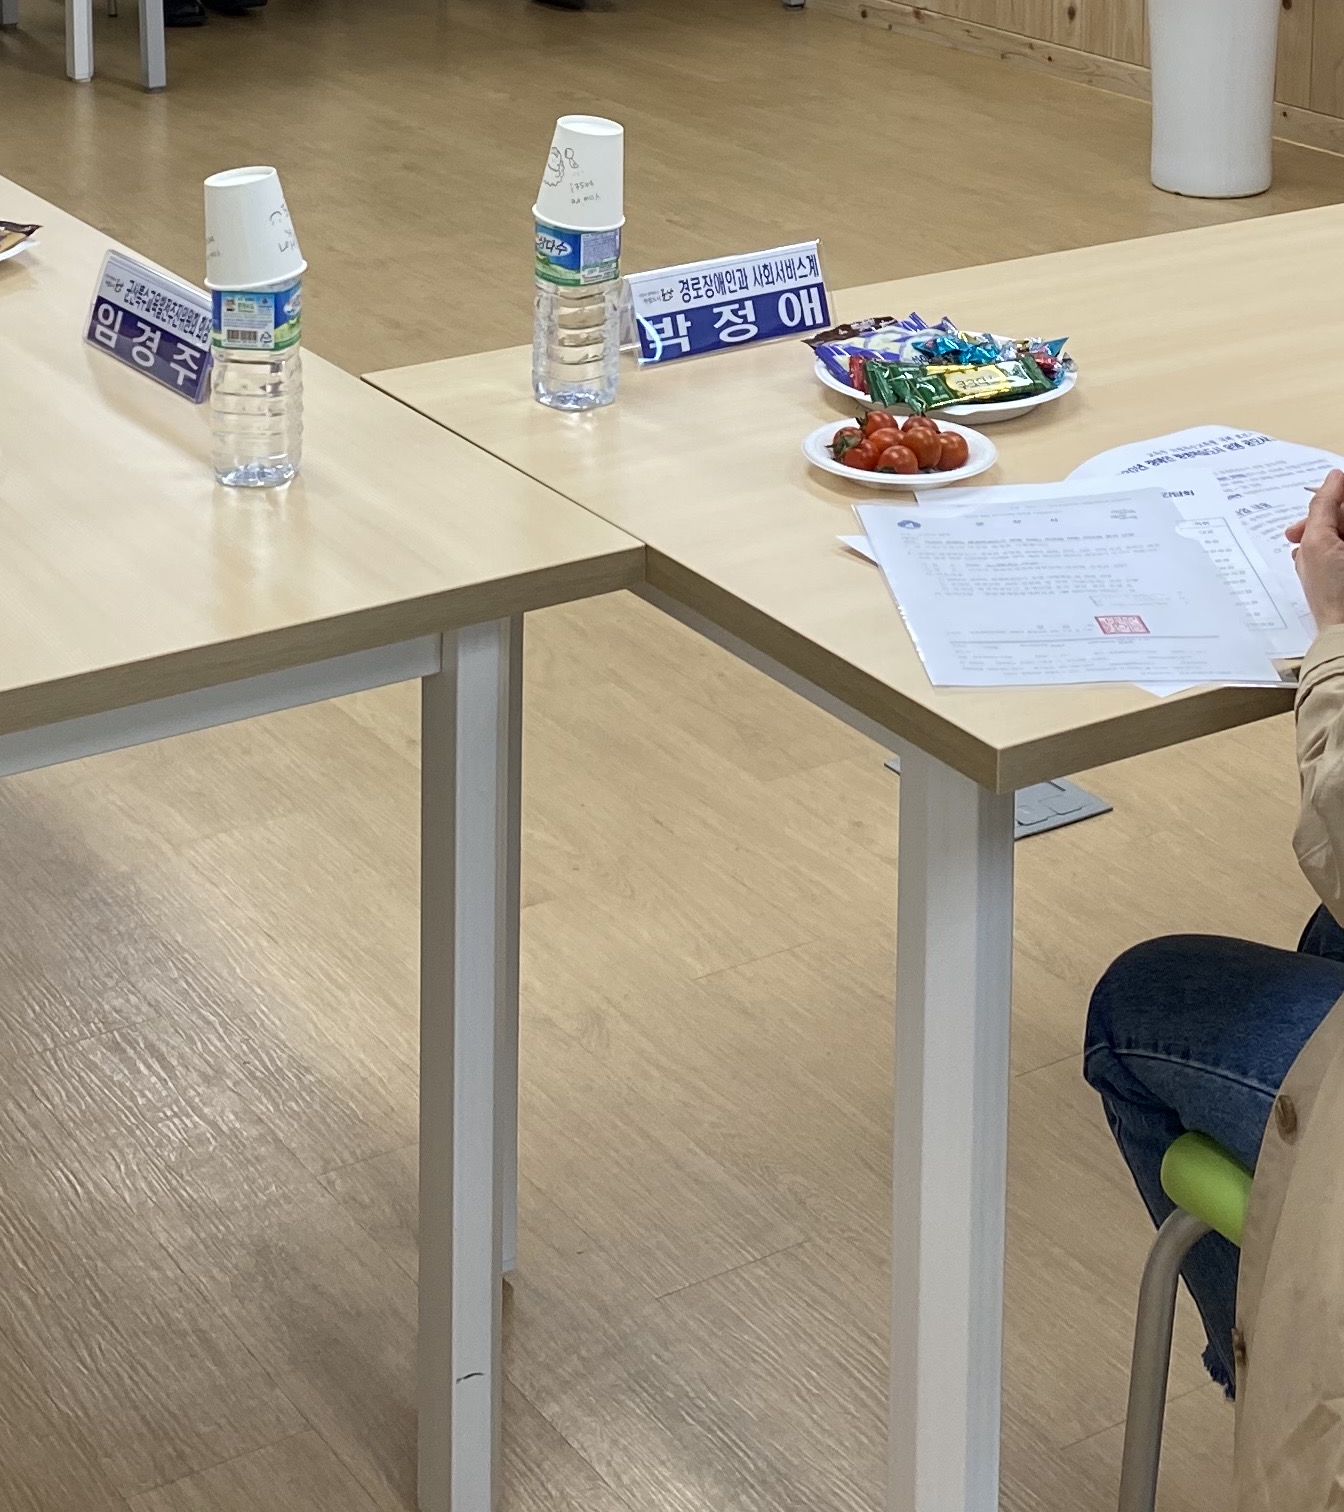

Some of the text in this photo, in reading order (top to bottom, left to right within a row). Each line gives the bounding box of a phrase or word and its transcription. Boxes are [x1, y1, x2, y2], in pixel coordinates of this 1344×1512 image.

[678, 268, 750, 304] 경로장애인과
[752, 253, 830, 289] 사회서비스계
[94, 302, 202, 387] 임경주
[644, 286, 825, 354] 박정애
